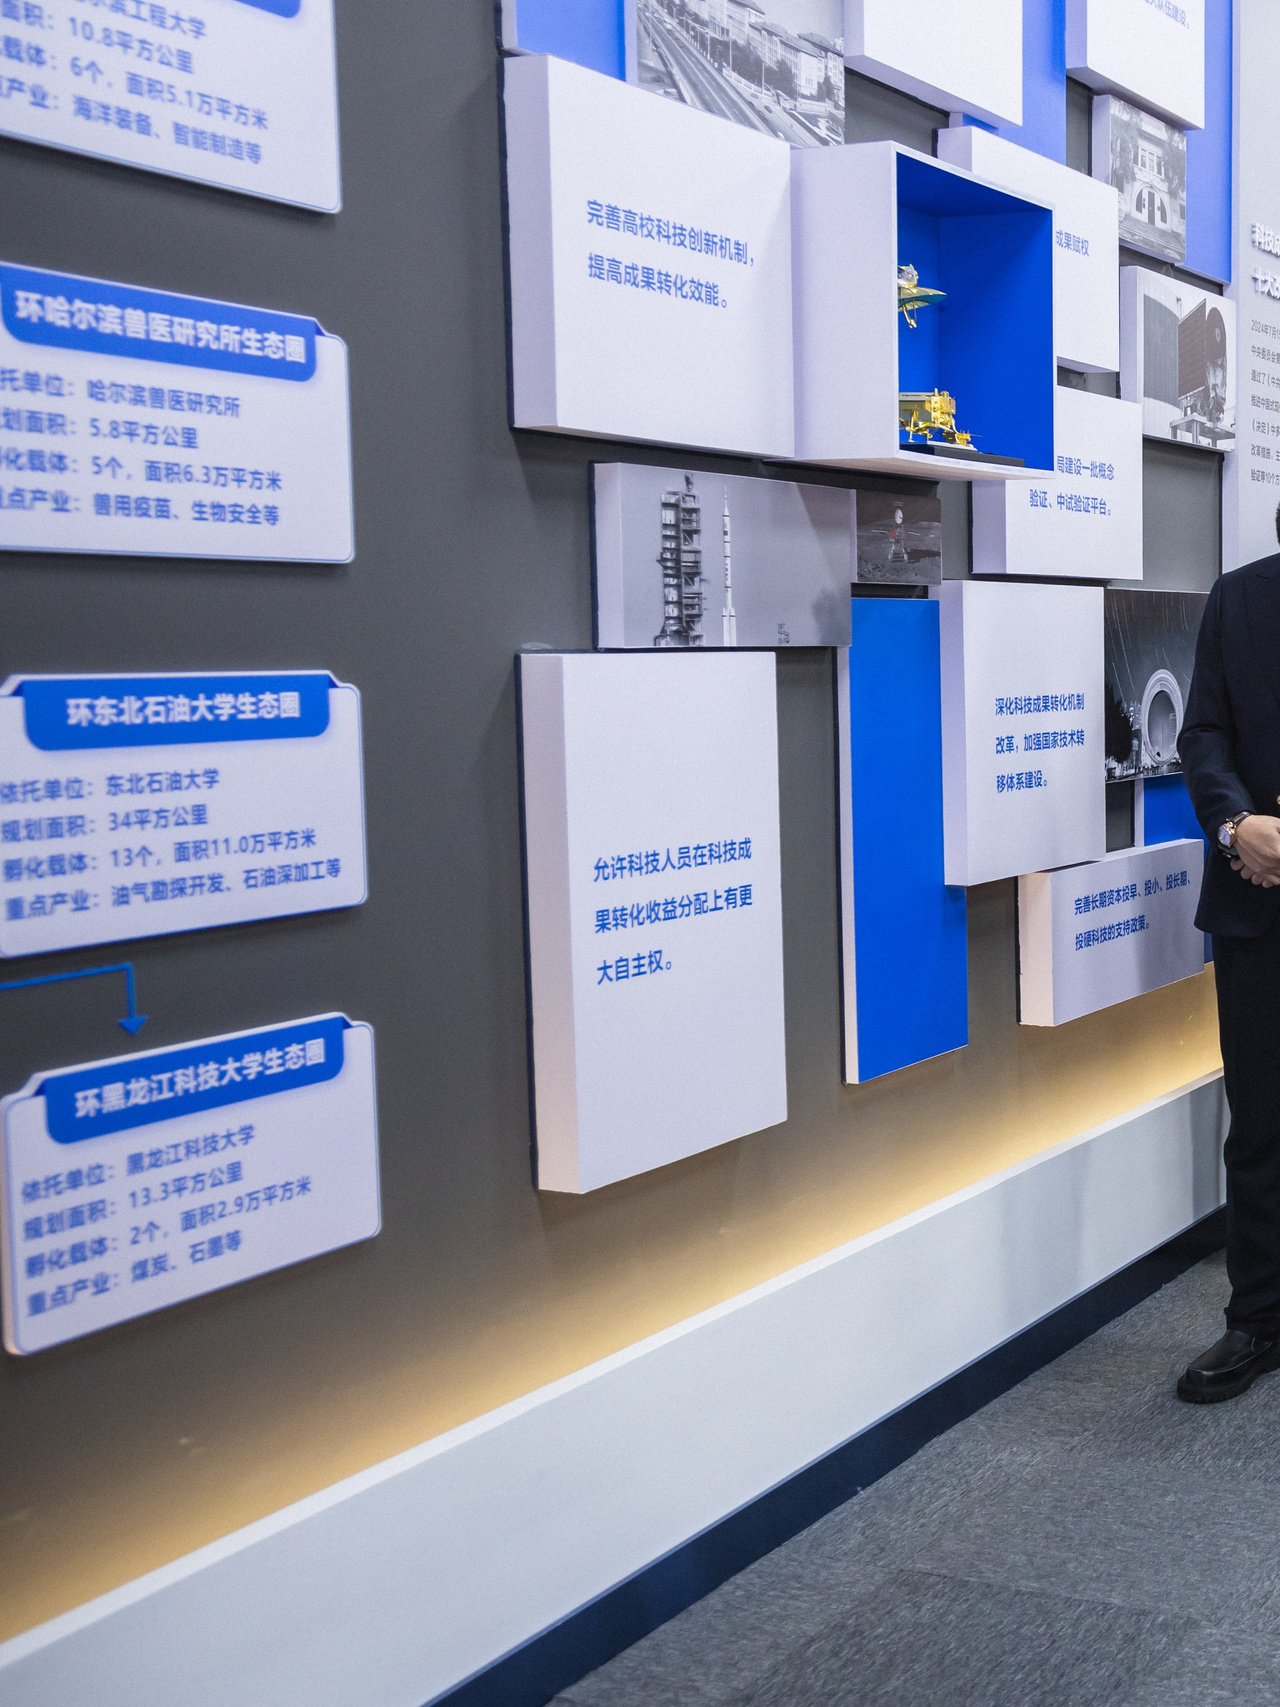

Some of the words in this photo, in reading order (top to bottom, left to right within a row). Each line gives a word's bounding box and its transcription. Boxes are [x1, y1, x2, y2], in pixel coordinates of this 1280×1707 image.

[0, 36, 268, 130] 载体：6个，面积5.1万平方米
[0, 76, 262, 164] 产业：海洋装备、智能制造等
[587, 199, 754, 267] 完善高校科技创新机制，
[588, 252, 727, 308] 提高成果转化效能。
[15, 290, 306, 363] 环哈尔滨兽医研究所生态圈
[0, 407, 199, 449] 划面积：5.8平方公里
[0, 447, 282, 491] 化载体：5个，面积6.3万平方米
[0, 487, 279, 526] 点产业：兽用疫苗、生物安全等
[66, 691, 301, 727] 环东北石油大学生态圈
[995, 692, 1085, 716] 深化科技成果转化机制
[995, 729, 1085, 755] 改革，加强国家技术转
[996, 770, 1048, 793] 移体系建设。
[593, 836, 752, 883] 允许科技人员在科技成
[595, 883, 753, 934] 果转化收益分配上有更
[597, 949, 672, 985] 大自主权。
[75, 1038, 326, 1119] 环黑龙江科技大学生态圈
